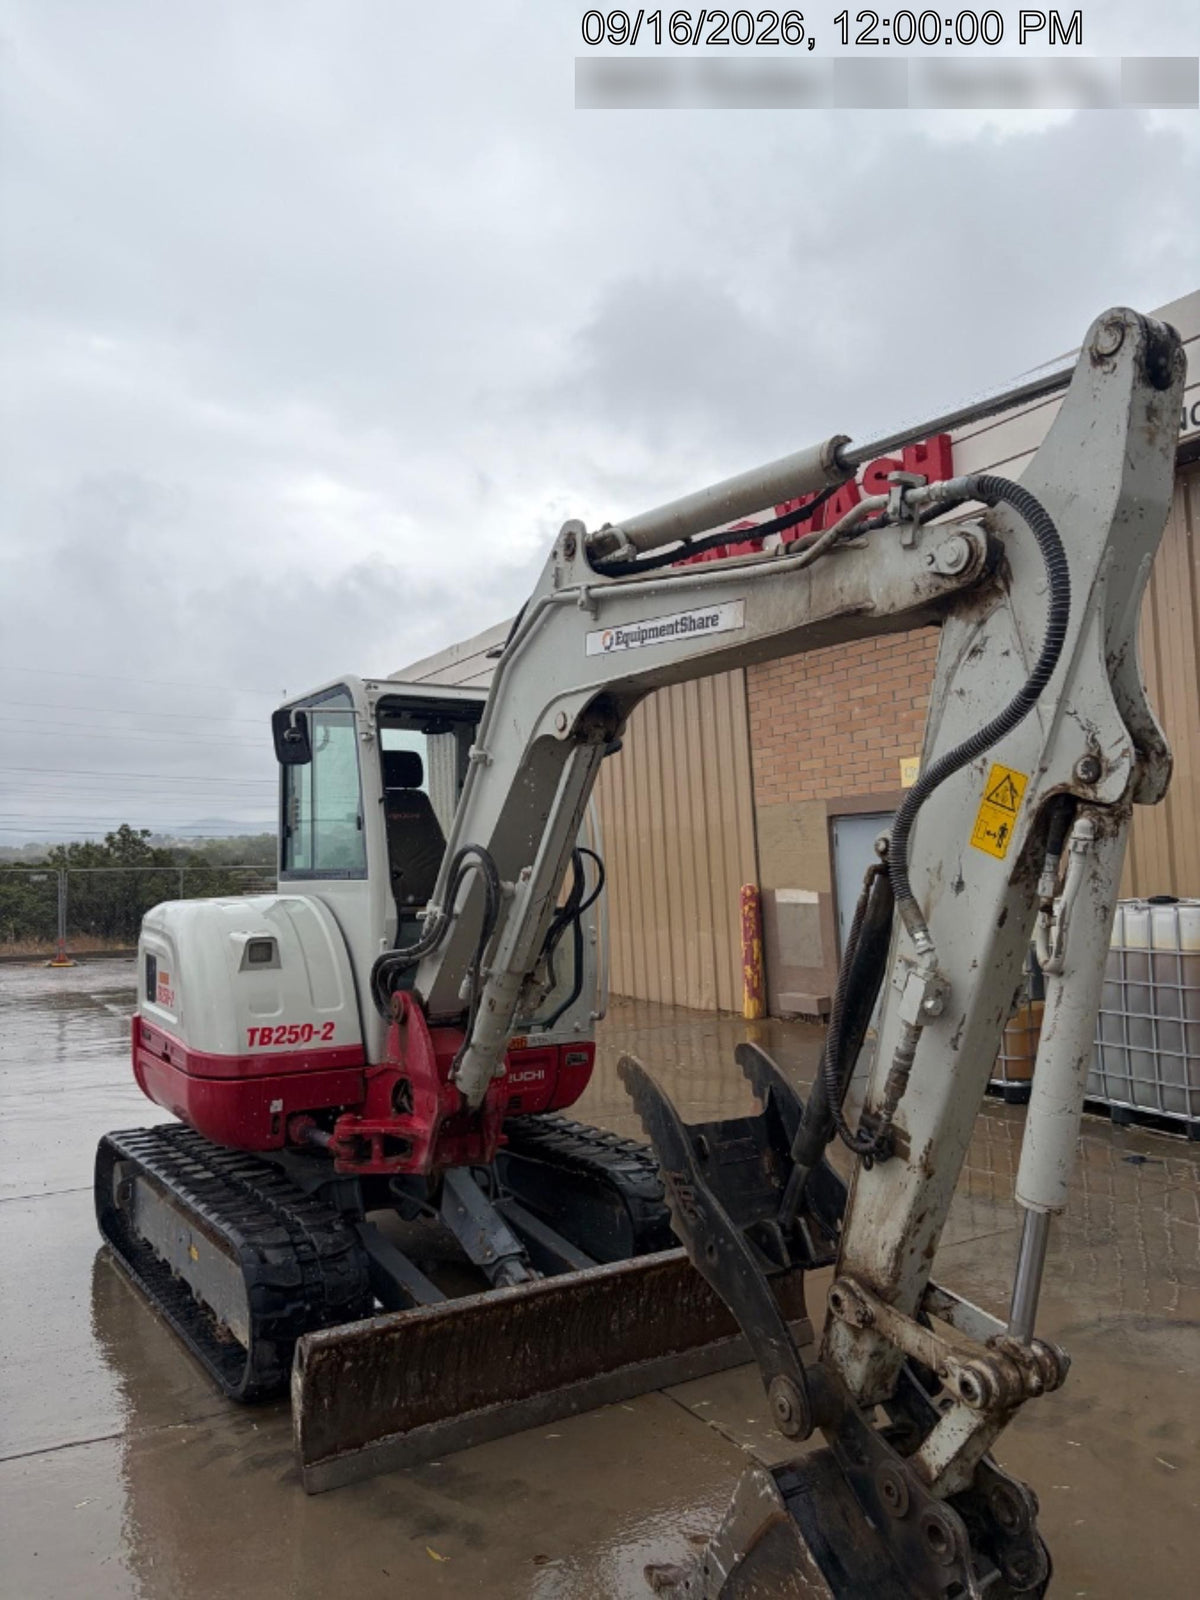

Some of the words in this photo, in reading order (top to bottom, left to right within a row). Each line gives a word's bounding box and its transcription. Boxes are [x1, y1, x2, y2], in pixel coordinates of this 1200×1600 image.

[614, 613, 720, 648] EquipmentShare
[246, 1021, 336, 1048] TB250-2
[508, 1069, 546, 1084] UCHI
